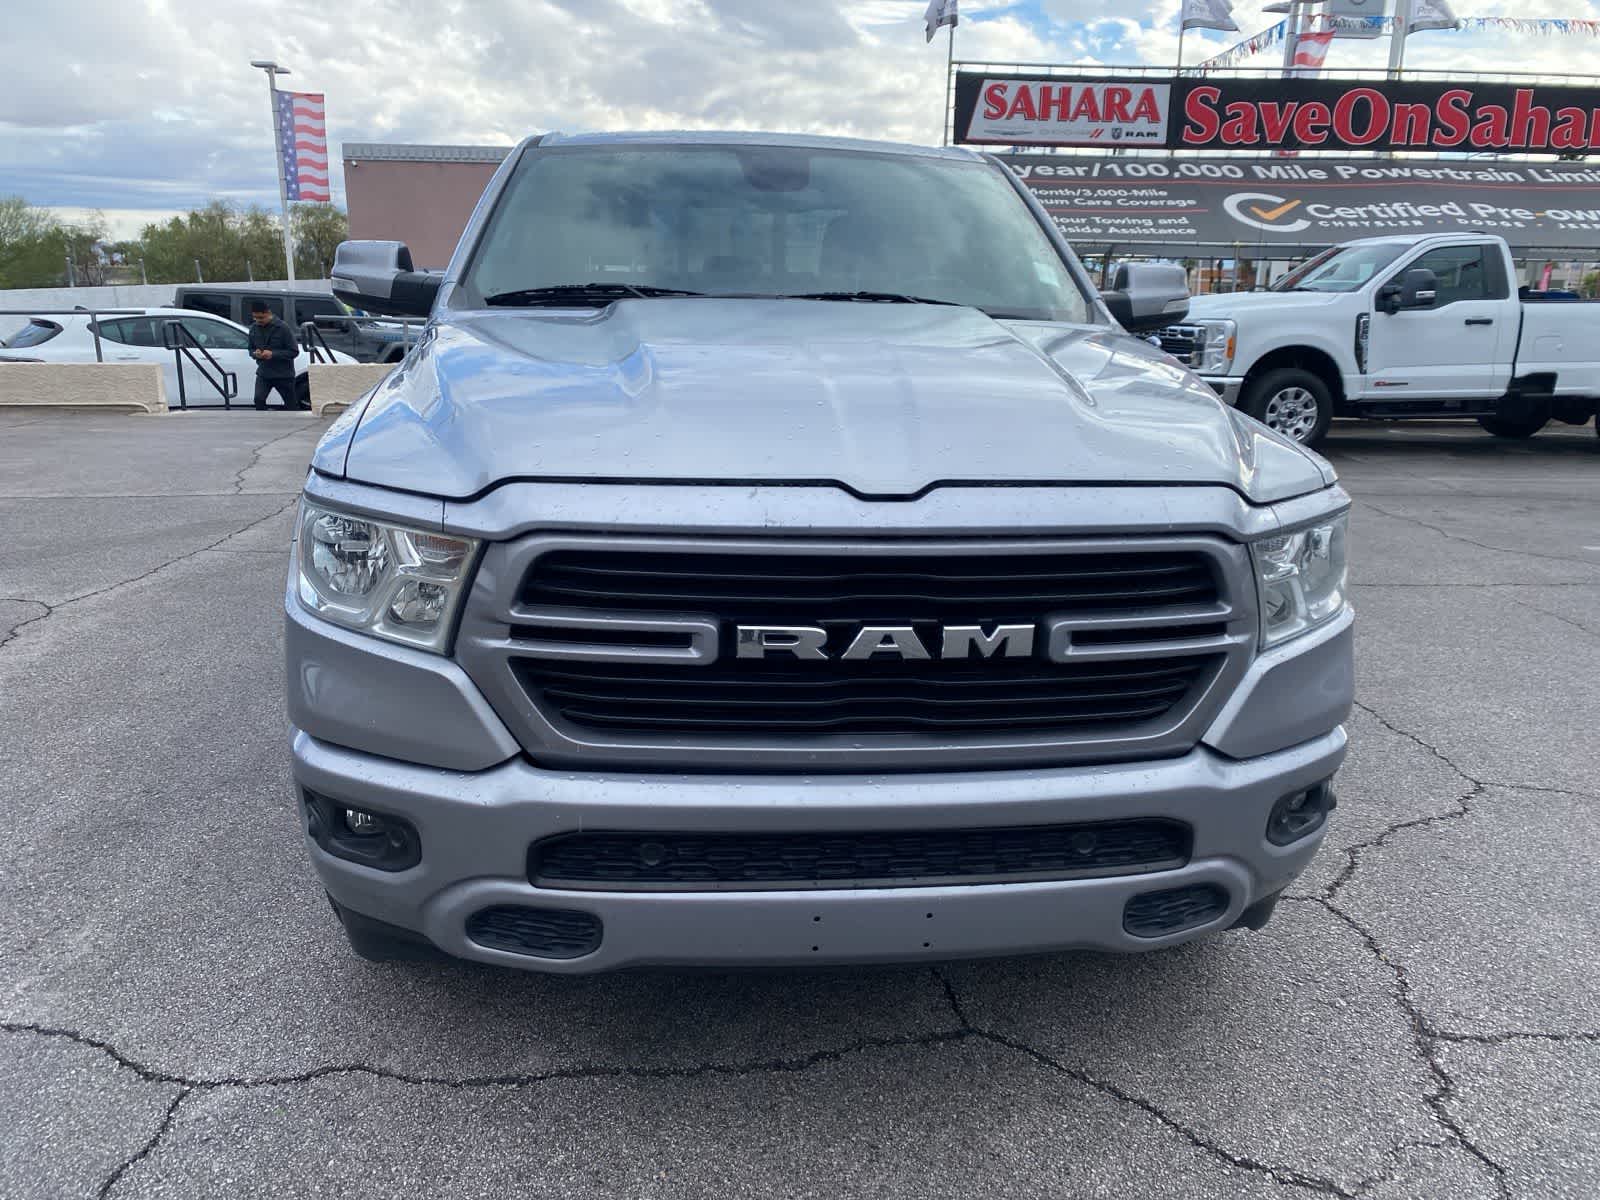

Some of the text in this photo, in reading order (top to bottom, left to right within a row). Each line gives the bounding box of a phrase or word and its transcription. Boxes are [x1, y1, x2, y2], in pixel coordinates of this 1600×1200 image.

[983, 82, 1162, 123] SAHARA
[1252, 165, 1328, 179] Mile
[1334, 165, 1525, 183] Powertrain
[1074, 198, 1112, 206] Care
[1117, 198, 1197, 207] Coverage
[1306, 202, 1466, 218] Certified
[1090, 216, 1153, 226] Towing
[1158, 216, 1189, 225] and
[1318, 220, 1424, 228] CHRYSLER
[1456, 218, 1526, 228] DODGE
[1108, 226, 1197, 235] Assistance
[736, 624, 1035, 660] RAM
